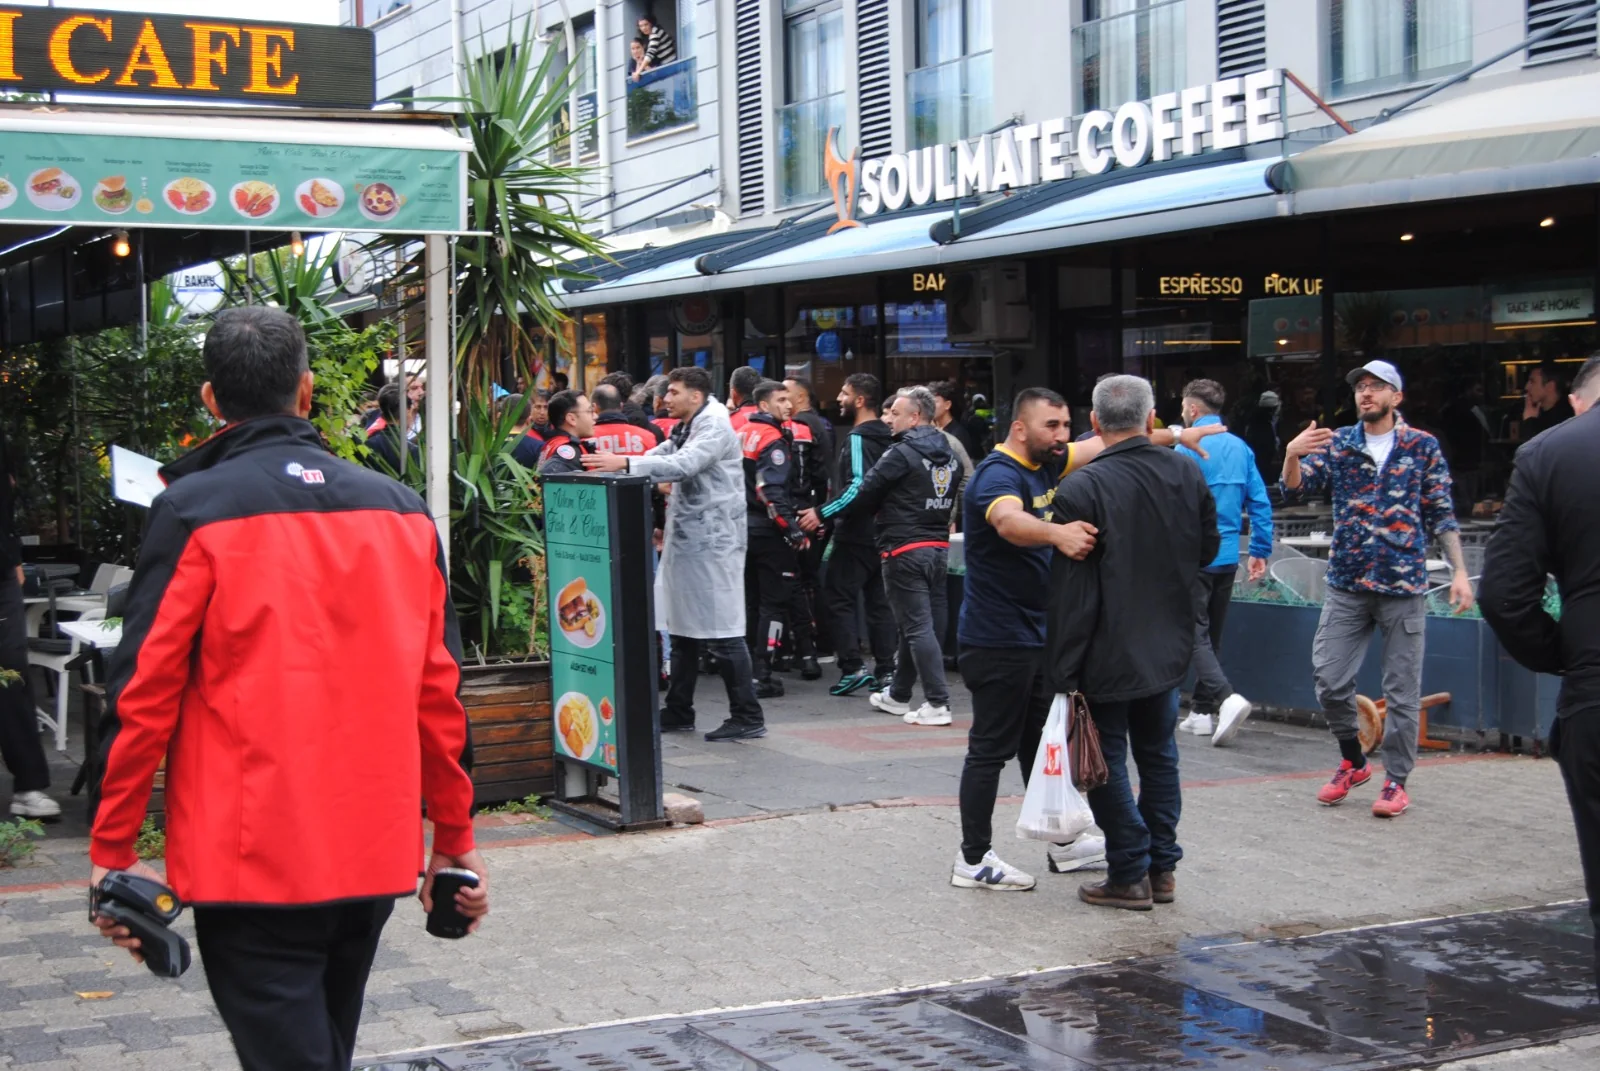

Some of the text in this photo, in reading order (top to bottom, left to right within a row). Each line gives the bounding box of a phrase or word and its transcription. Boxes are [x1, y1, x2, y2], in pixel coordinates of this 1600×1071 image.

[48, 15, 300, 95] CAFE
[859, 68, 1287, 216] SOULMATE COFFEE
[1159, 276, 1243, 295] ESPRESSO
[1264, 276, 1300, 294] PICK
[1506, 297, 1581, 314] TAKE ME HOME
